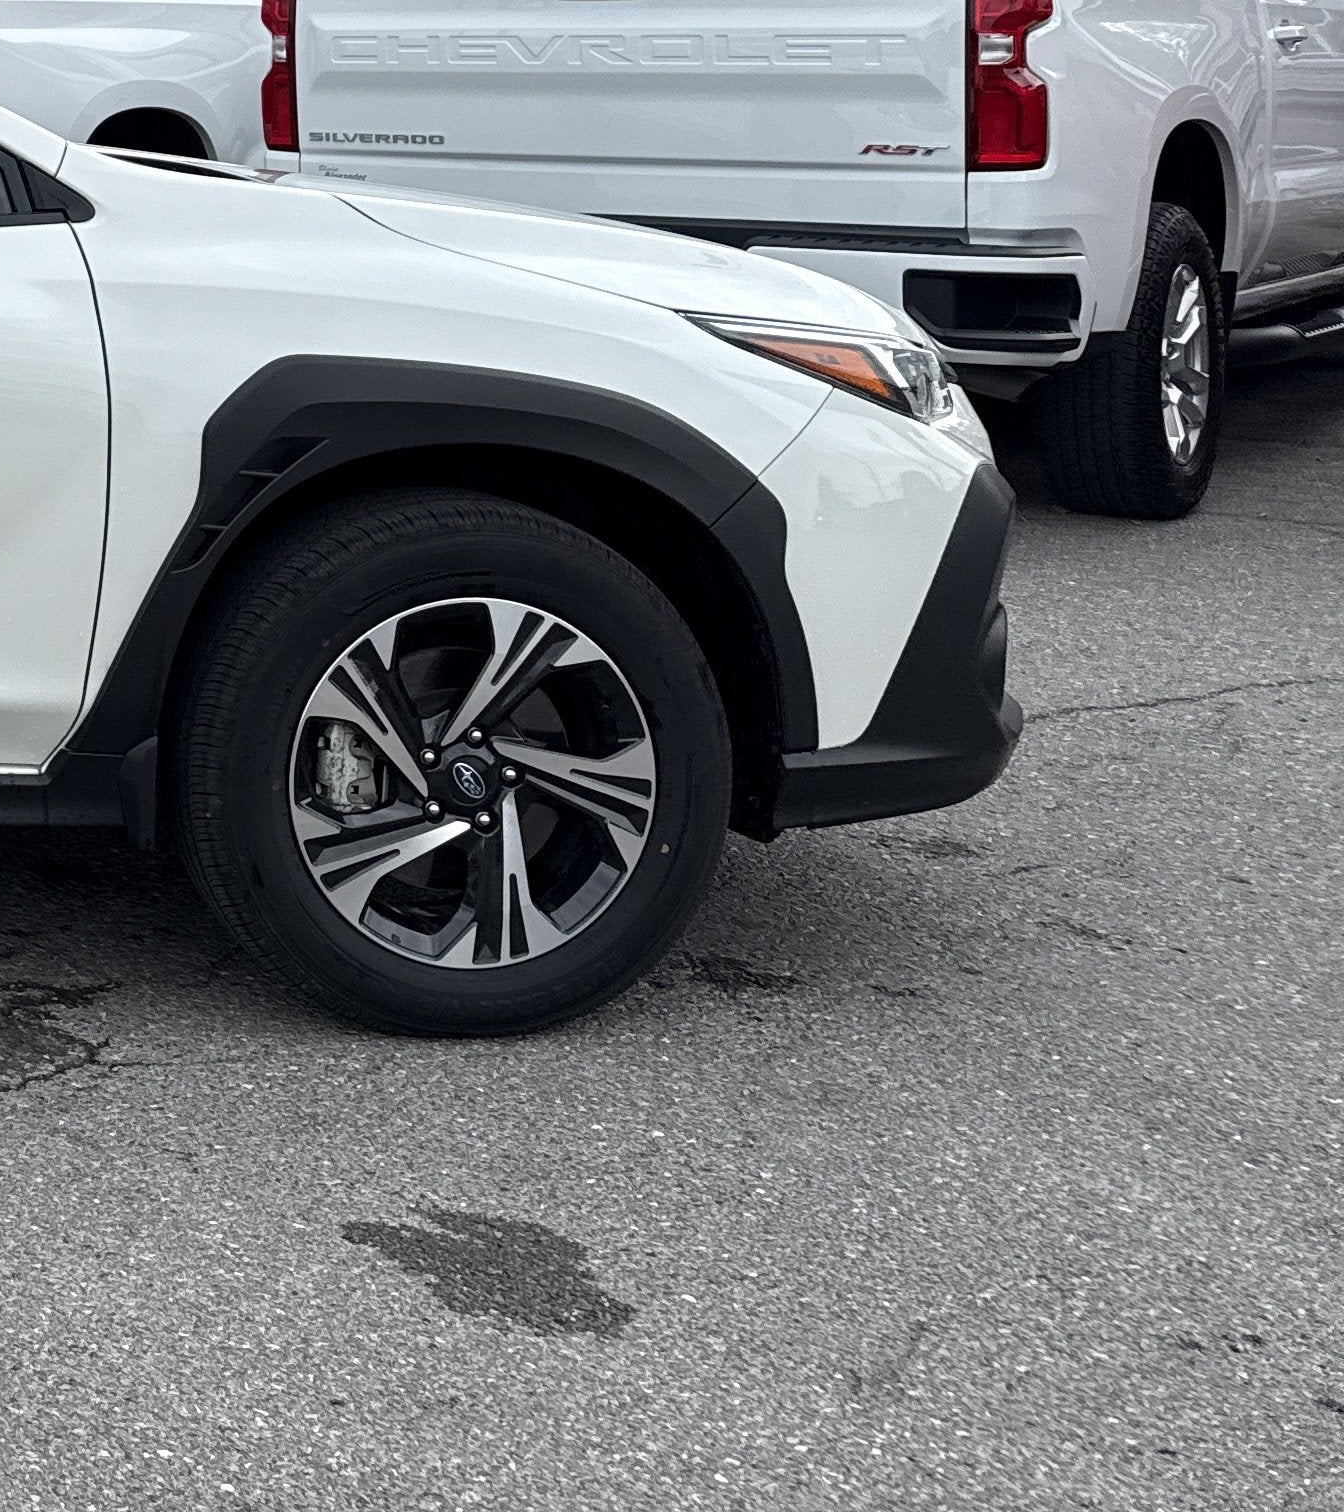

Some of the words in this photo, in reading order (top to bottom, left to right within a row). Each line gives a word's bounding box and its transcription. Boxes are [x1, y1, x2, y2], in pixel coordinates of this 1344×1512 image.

[330, 33, 907, 66] CHEVROLET
[308, 131, 446, 145] SILVERADO
[857, 144, 951, 157] RST
